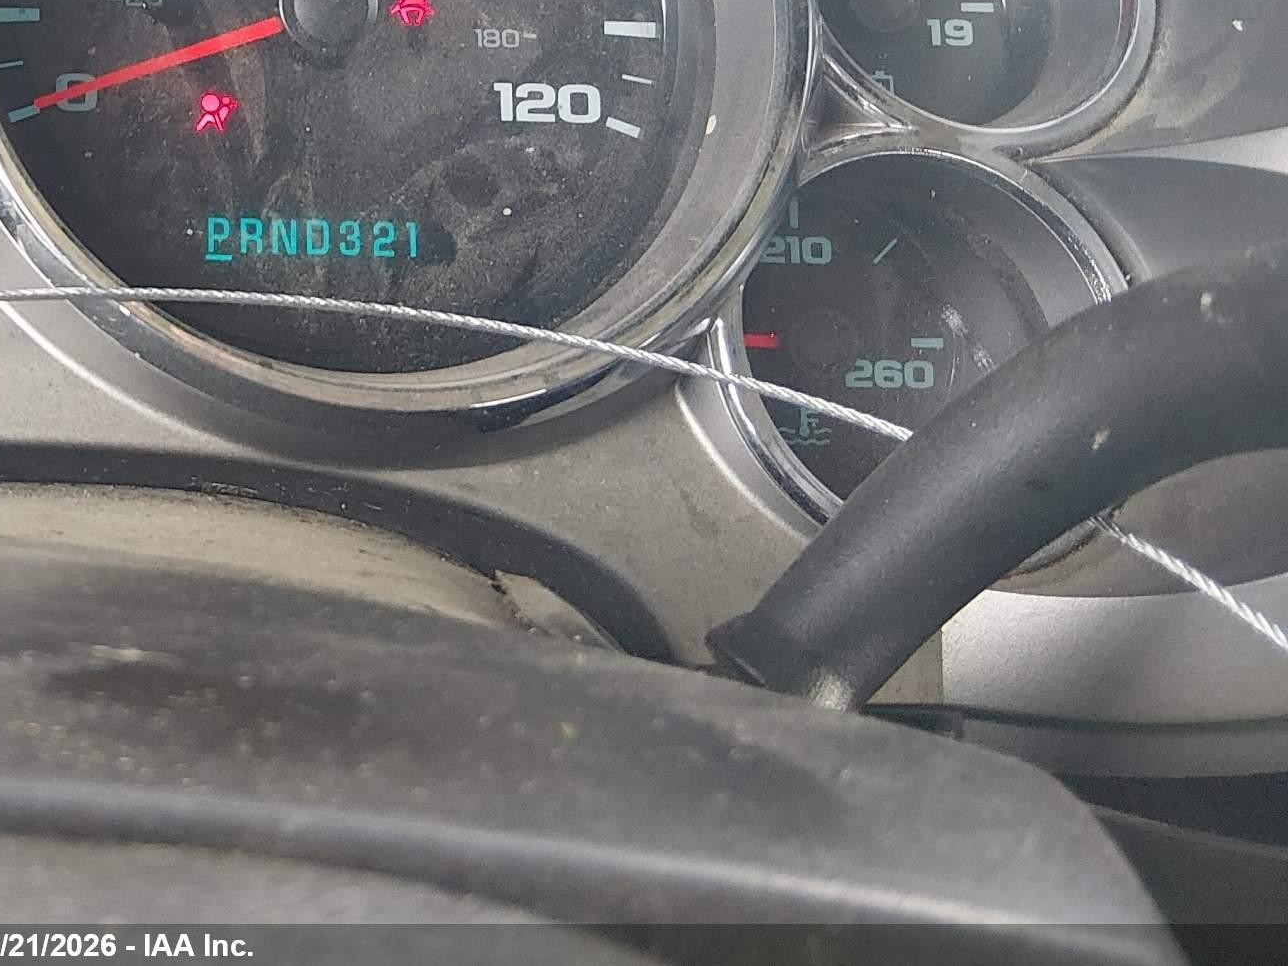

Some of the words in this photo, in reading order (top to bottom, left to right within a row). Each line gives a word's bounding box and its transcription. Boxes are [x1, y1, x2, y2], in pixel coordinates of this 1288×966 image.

[475, 30, 519, 49] 180
[926, 19, 974, 46] 19
[55, 73, 98, 112] 0
[493, 83, 601, 122] 120
[760, 236, 832, 265] 210
[845, 359, 934, 388] 260
